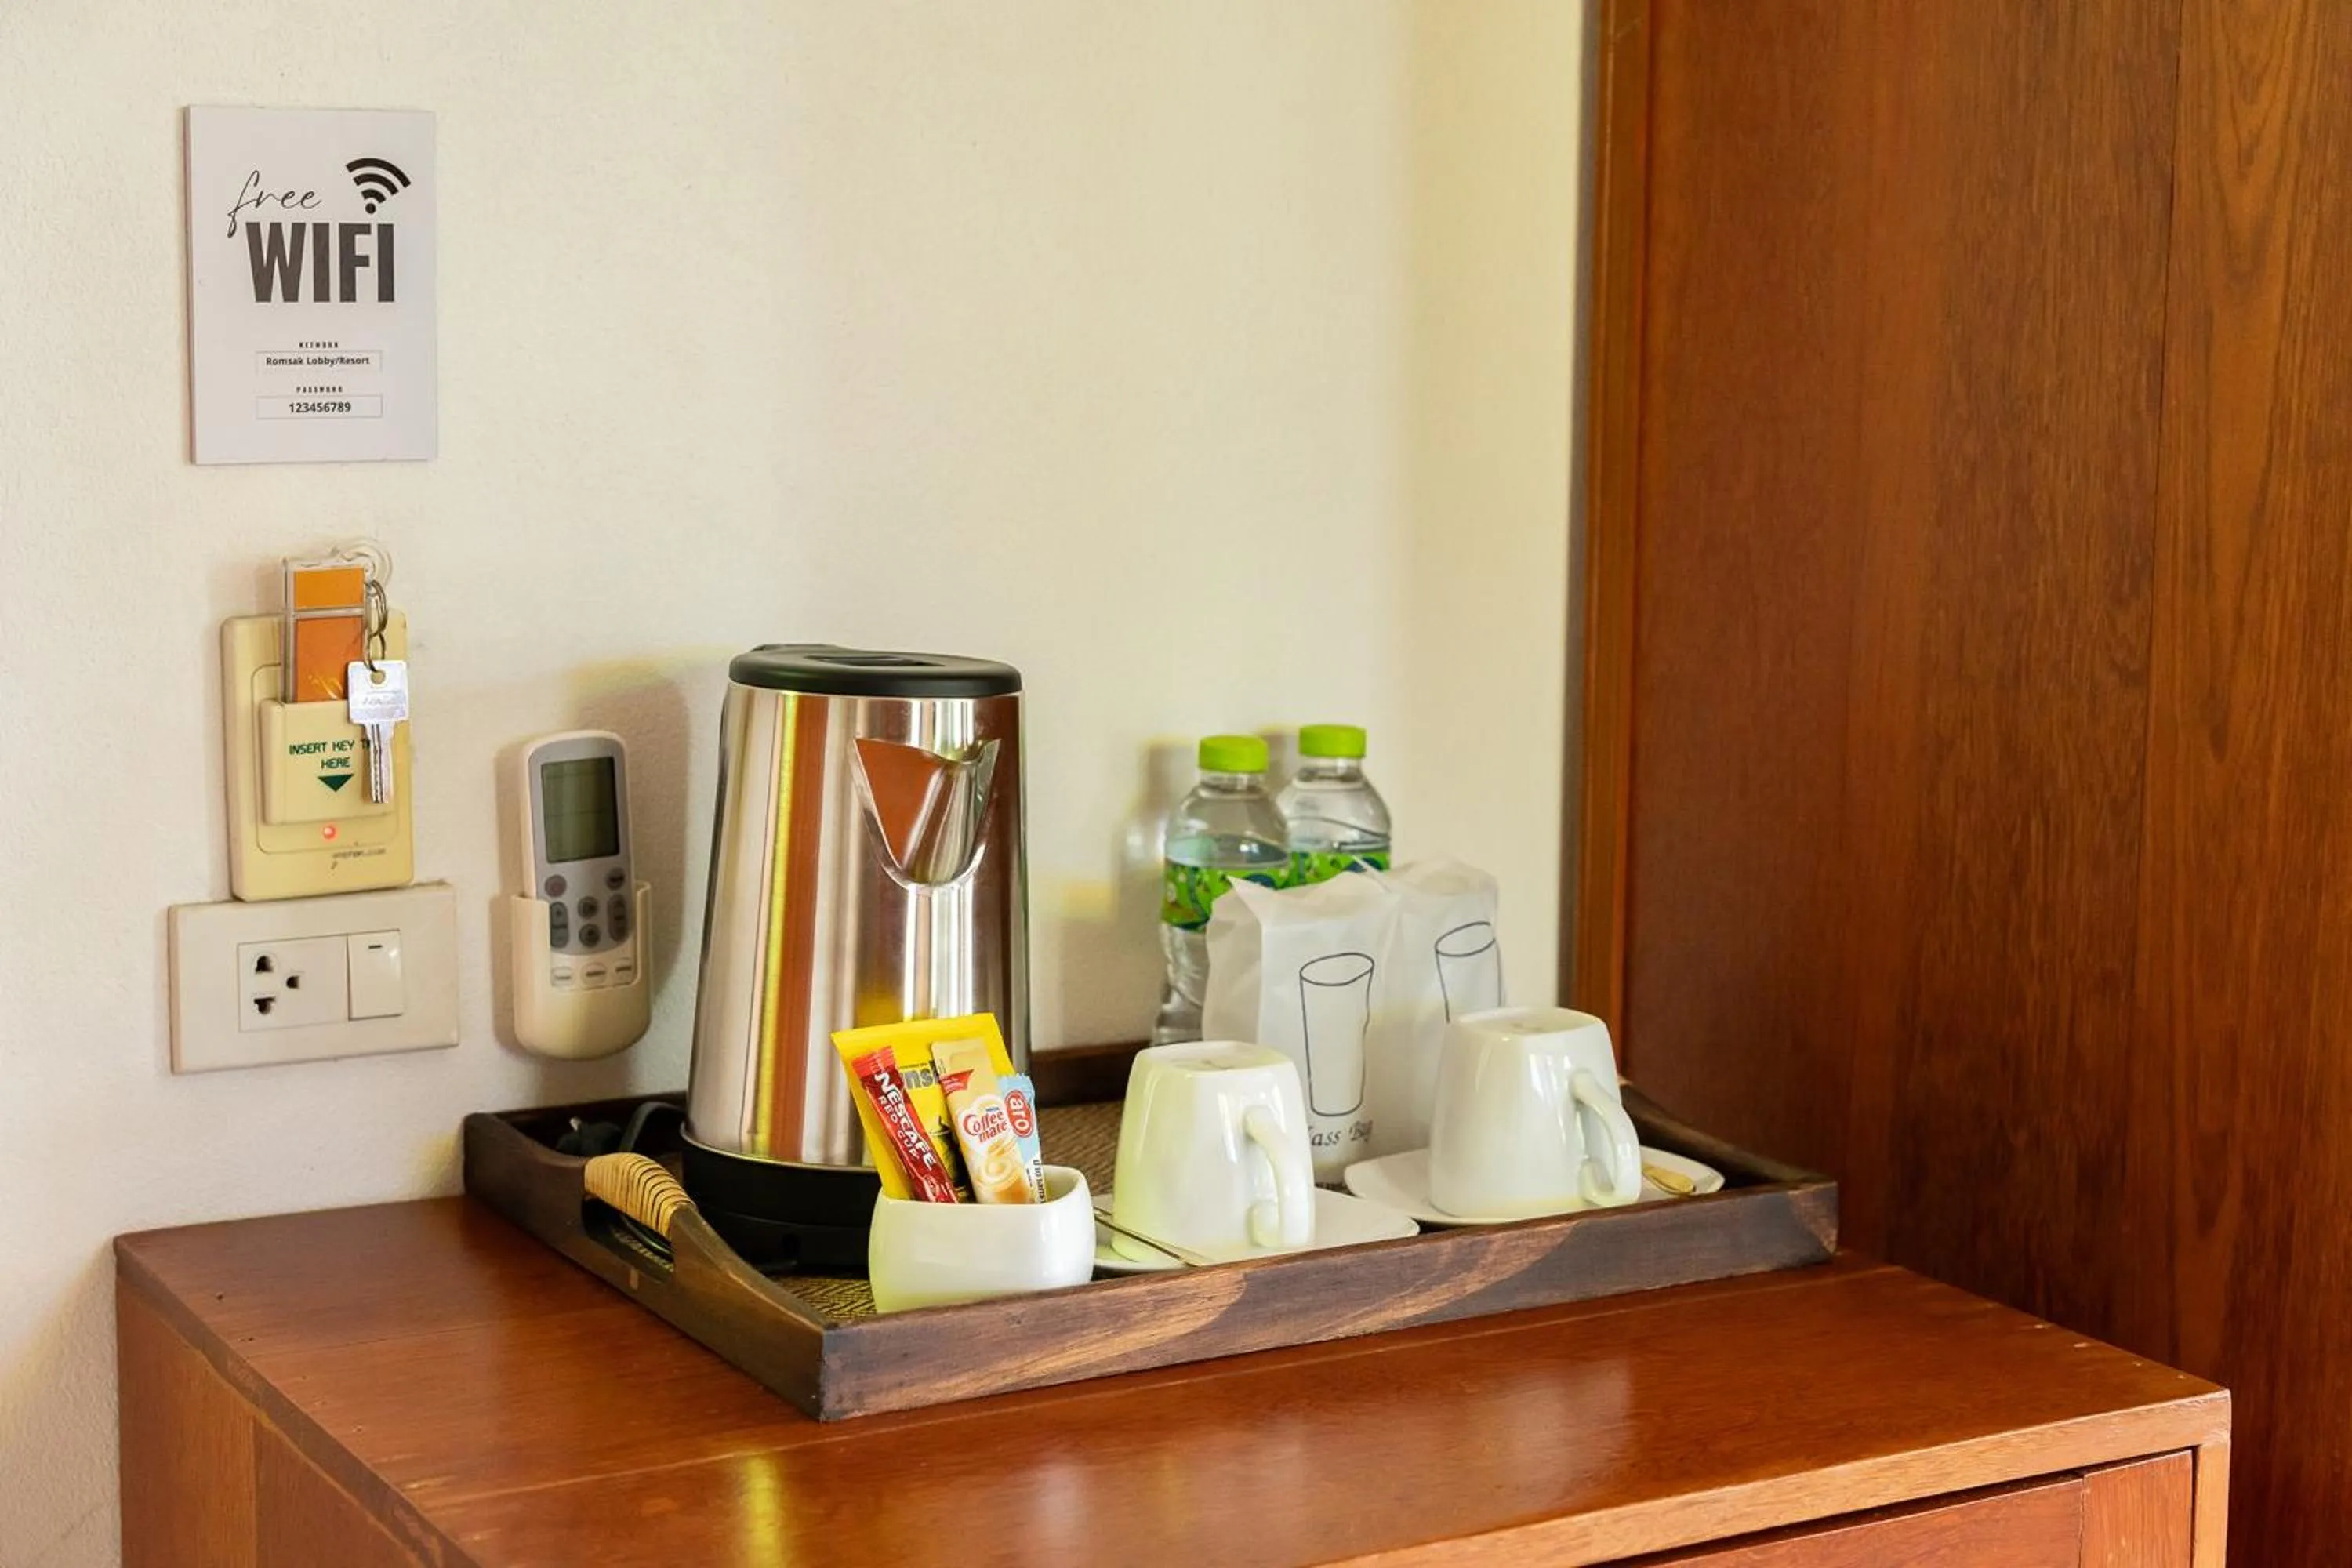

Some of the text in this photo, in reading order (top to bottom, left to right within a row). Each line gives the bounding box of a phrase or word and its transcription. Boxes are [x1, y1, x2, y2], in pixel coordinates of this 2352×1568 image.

[227, 169, 323, 238] free
[245, 221, 395, 303] WIFI
[266, 357, 370, 368] Romsak Lobby/Resort
[289, 402, 352, 414] 123456789
[289, 742, 327, 755] INSERT
[332, 739, 355, 752] KEY
[321, 757, 351, 769] HERE
[963, 1111, 1004, 1136] Coffee
[1009, 1097, 1030, 1131] aro
[877, 1095, 920, 1160] RED CUP
[978, 1120, 1008, 1144] mate
